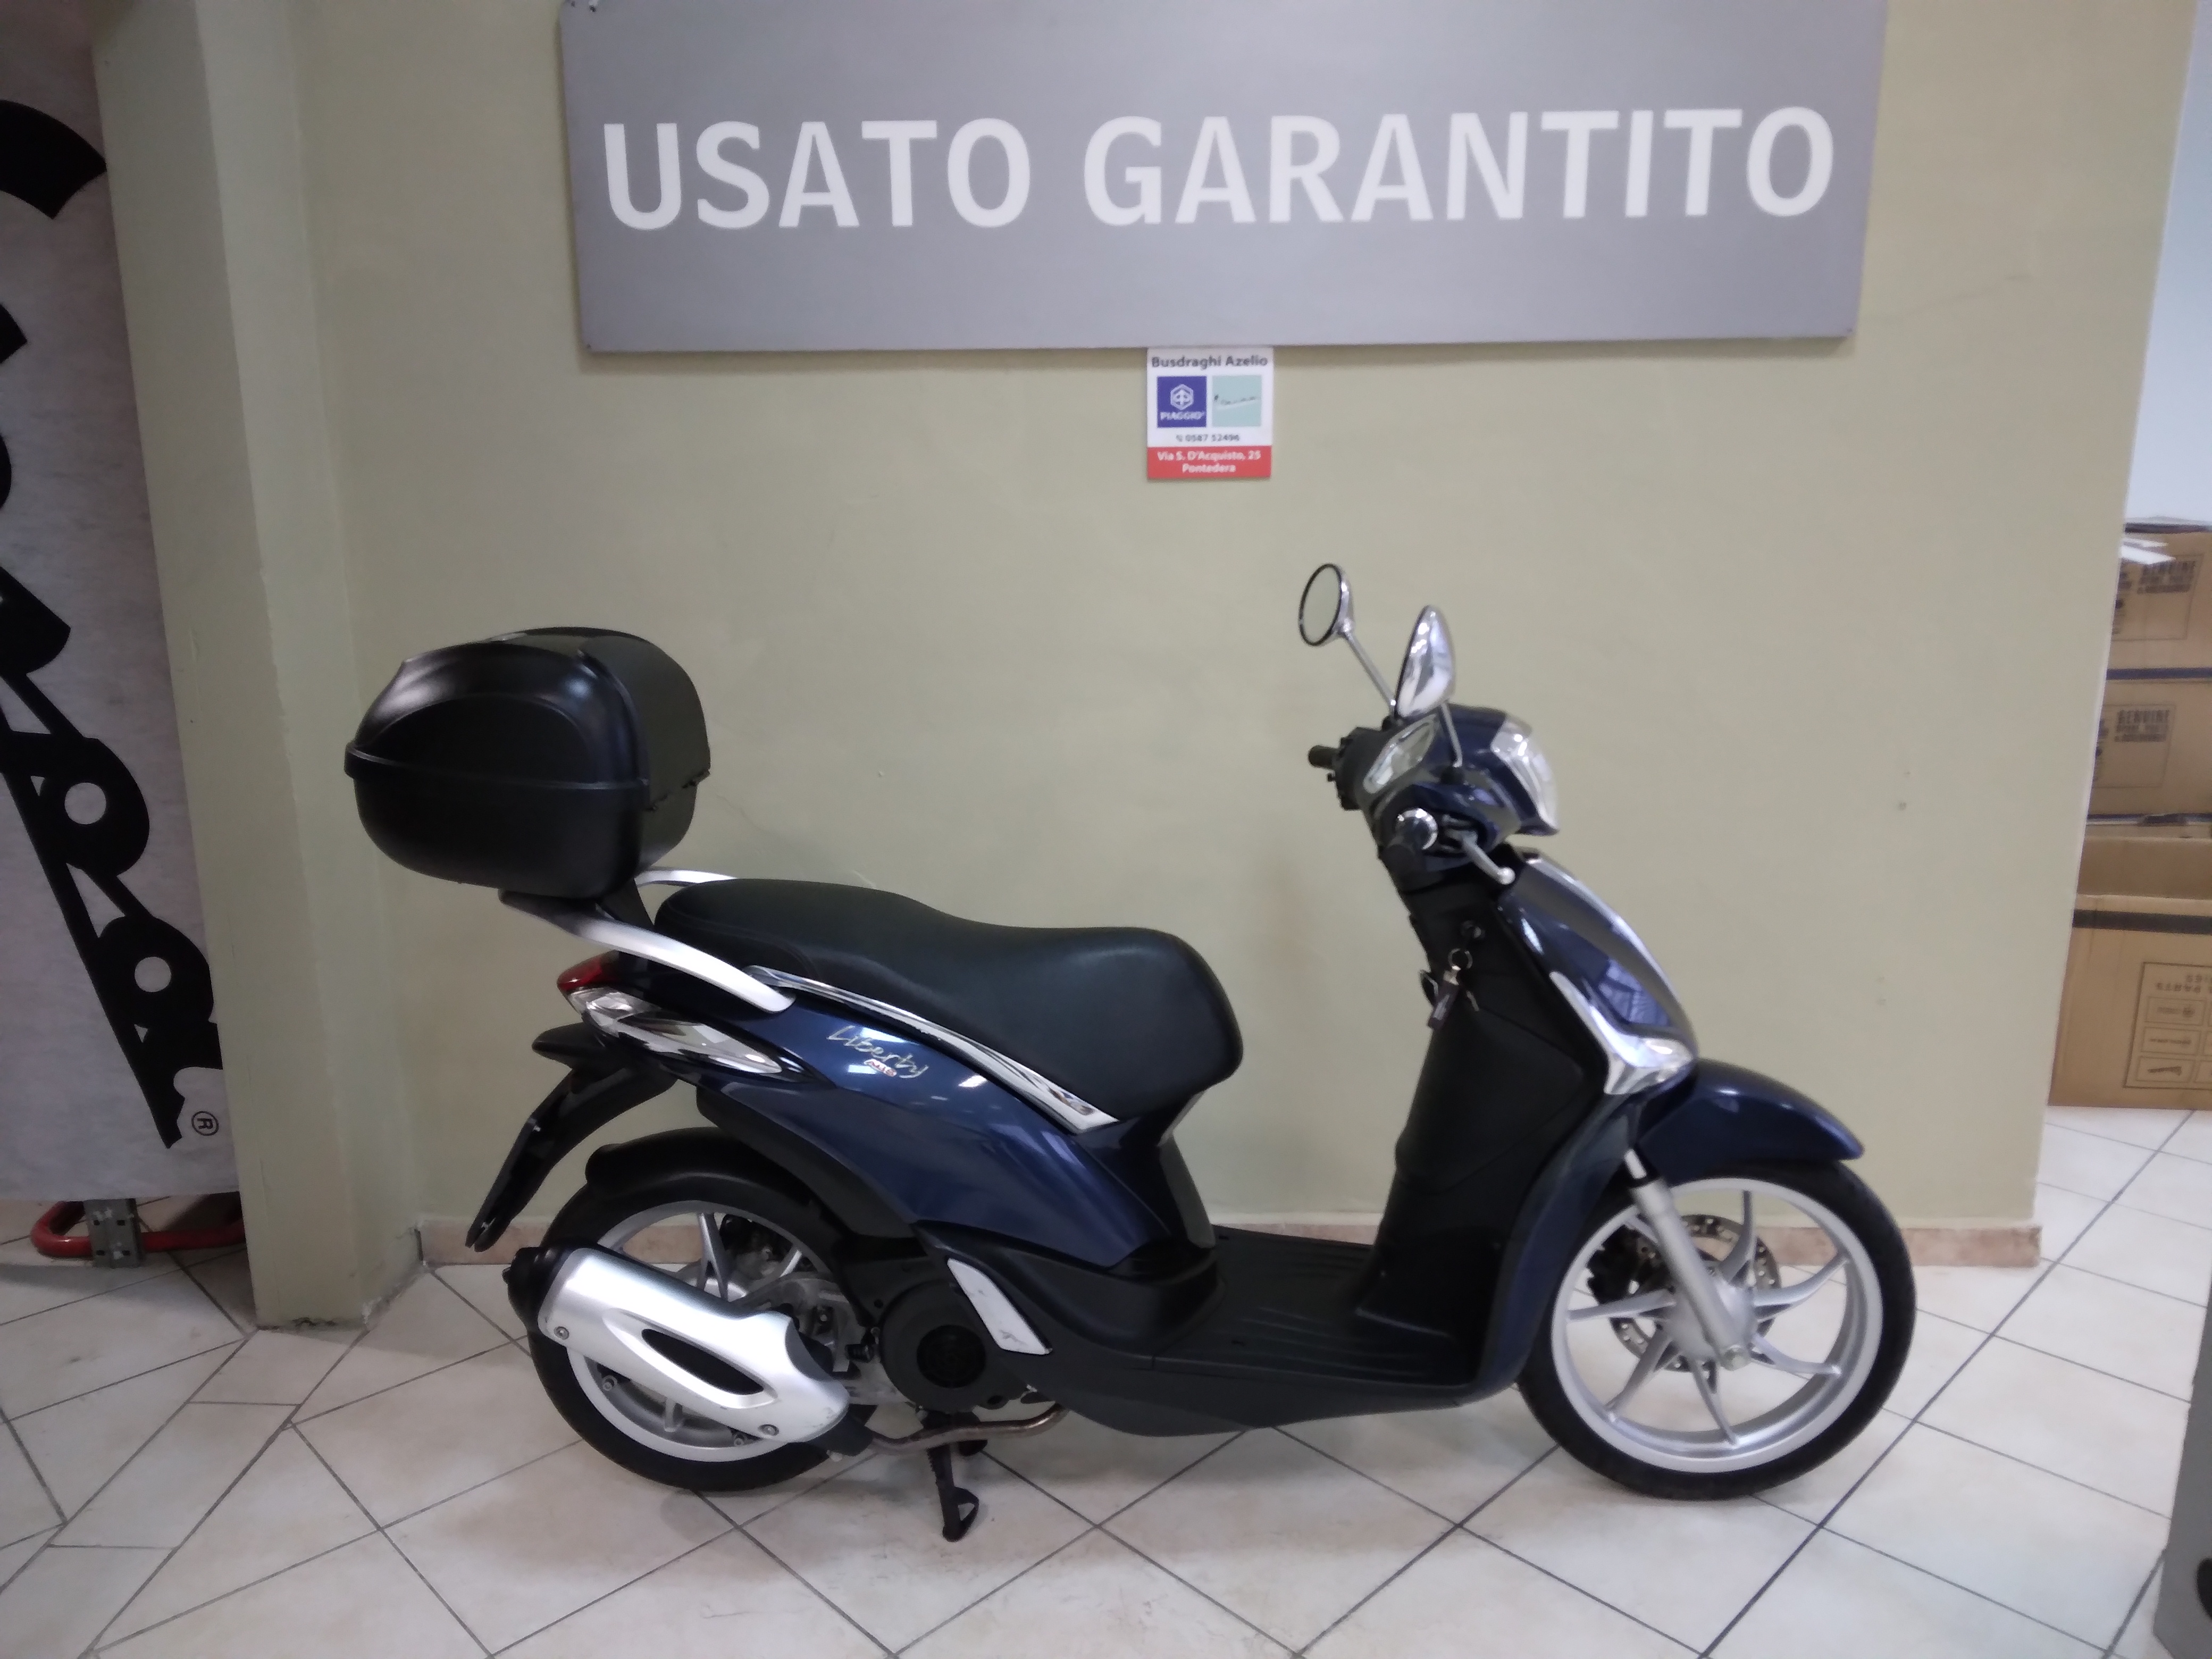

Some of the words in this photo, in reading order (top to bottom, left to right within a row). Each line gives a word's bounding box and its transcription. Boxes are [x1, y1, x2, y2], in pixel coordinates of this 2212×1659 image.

[604, 118, 1030, 230] USATO
[1083, 107, 1834, 225] GARANTITO
[1151, 355, 1221, 370] Busdraghi
[1225, 355, 1268, 366] Azelio
[1160, 412, 1203, 421] PIAGGIO
[1157, 451, 1174, 460] Via
[1176, 451, 1186, 460] S.
[1187, 450, 1246, 462] D'Acquisto,
[1248, 450, 1261, 460] 25
[1182, 463, 1236, 473] Pontedera
[826, 1026, 928, 1078] Liberty
